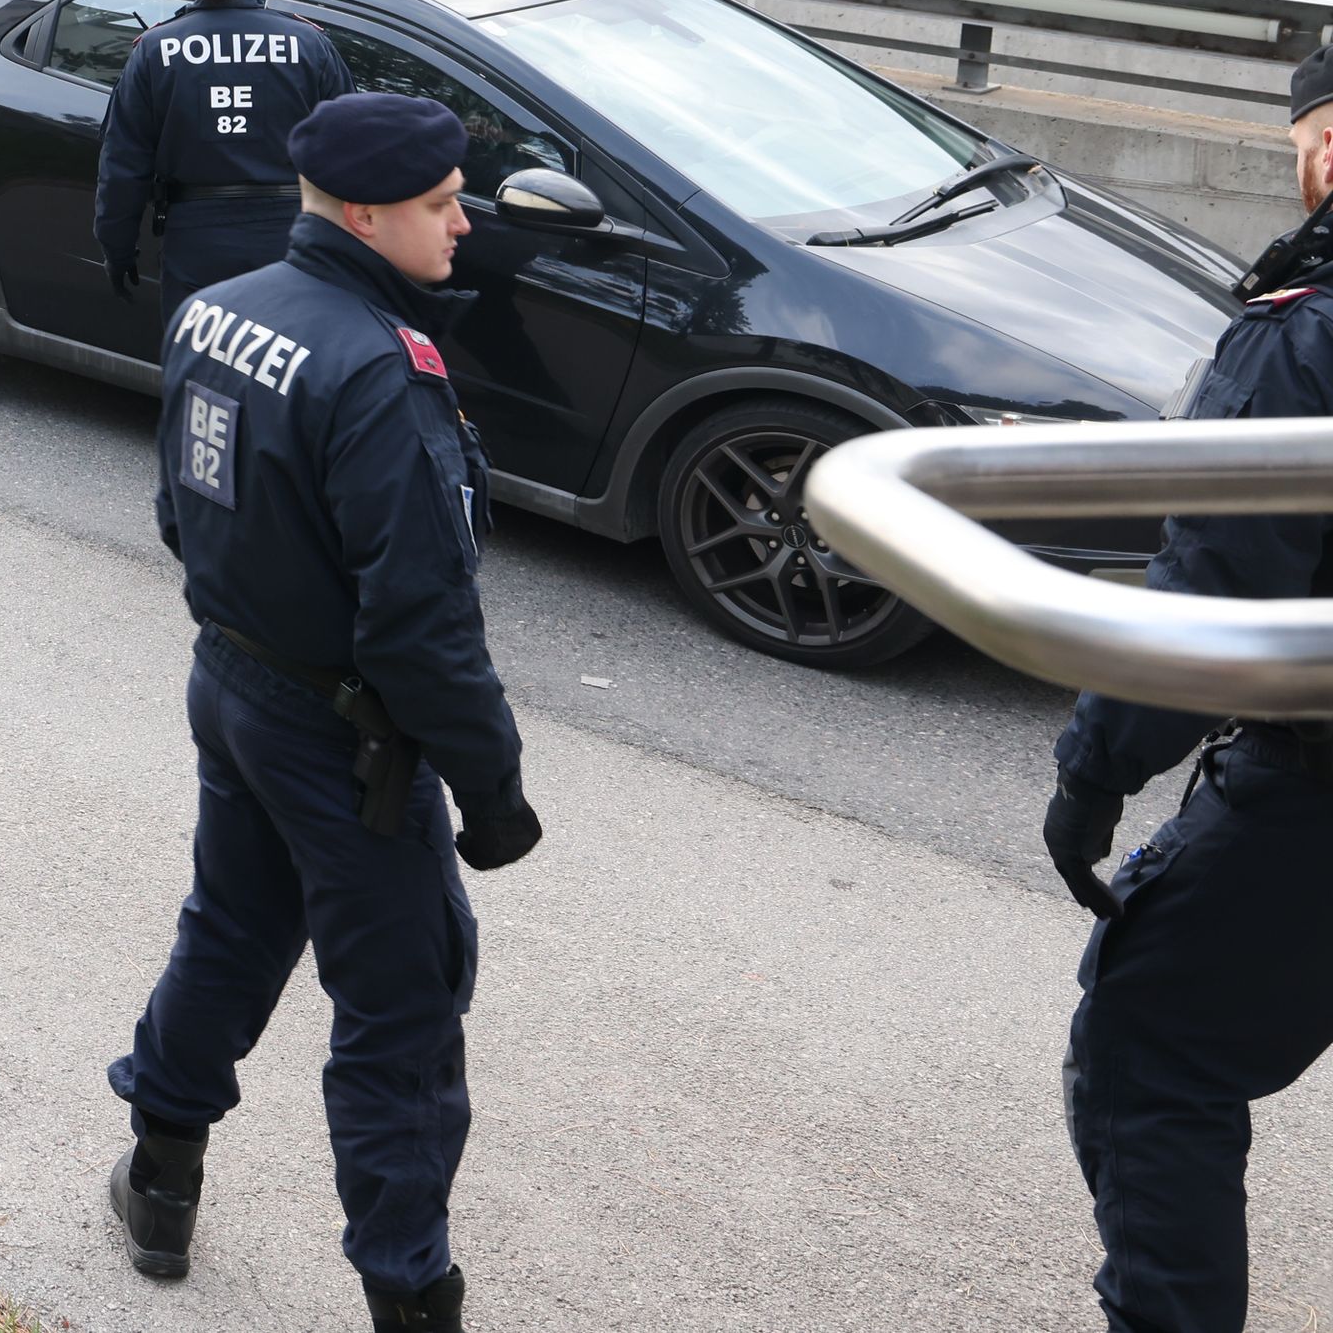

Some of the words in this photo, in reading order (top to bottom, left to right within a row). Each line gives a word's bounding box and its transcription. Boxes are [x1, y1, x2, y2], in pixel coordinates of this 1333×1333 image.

[160, 33, 300, 67] POLIZEI
[210, 86, 253, 108] BE
[217, 115, 247, 133] 82
[173, 299, 311, 396] POLIZEI
[189, 395, 230, 450] BE
[191, 440, 221, 490] 82
